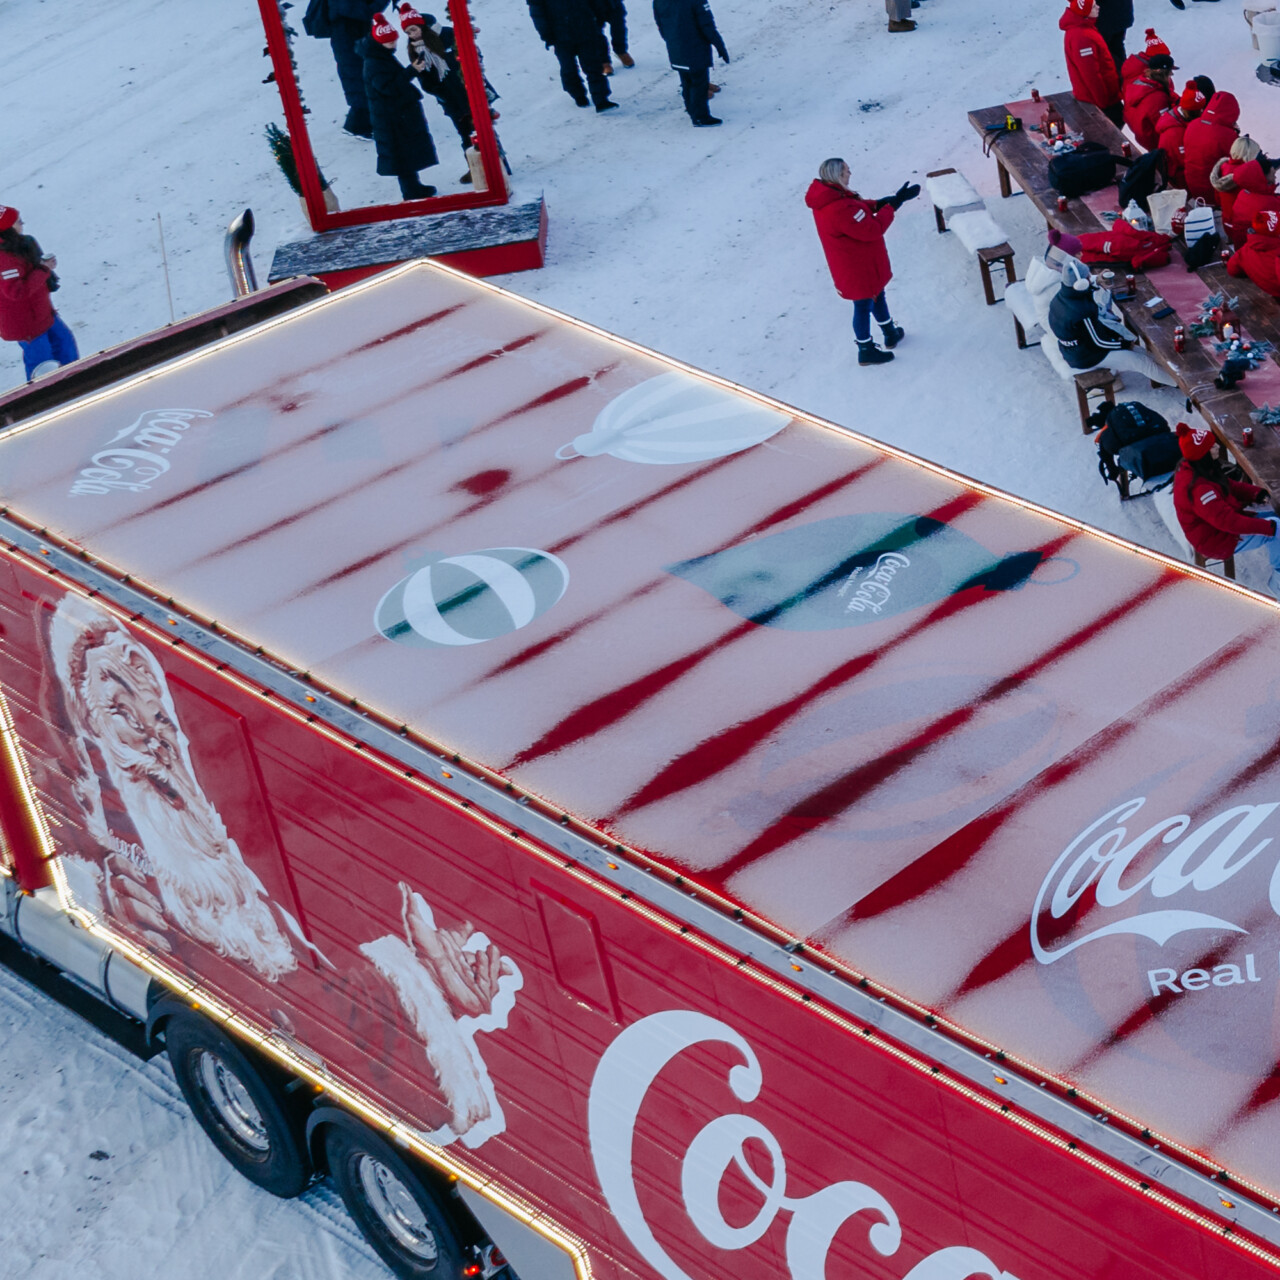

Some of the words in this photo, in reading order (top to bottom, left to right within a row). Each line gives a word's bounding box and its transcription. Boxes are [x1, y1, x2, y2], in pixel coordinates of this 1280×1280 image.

[68, 408, 214, 497] Coca-Cola
[846, 552, 911, 615] Coca-Cola
[1146, 952, 1262, 997] Real
